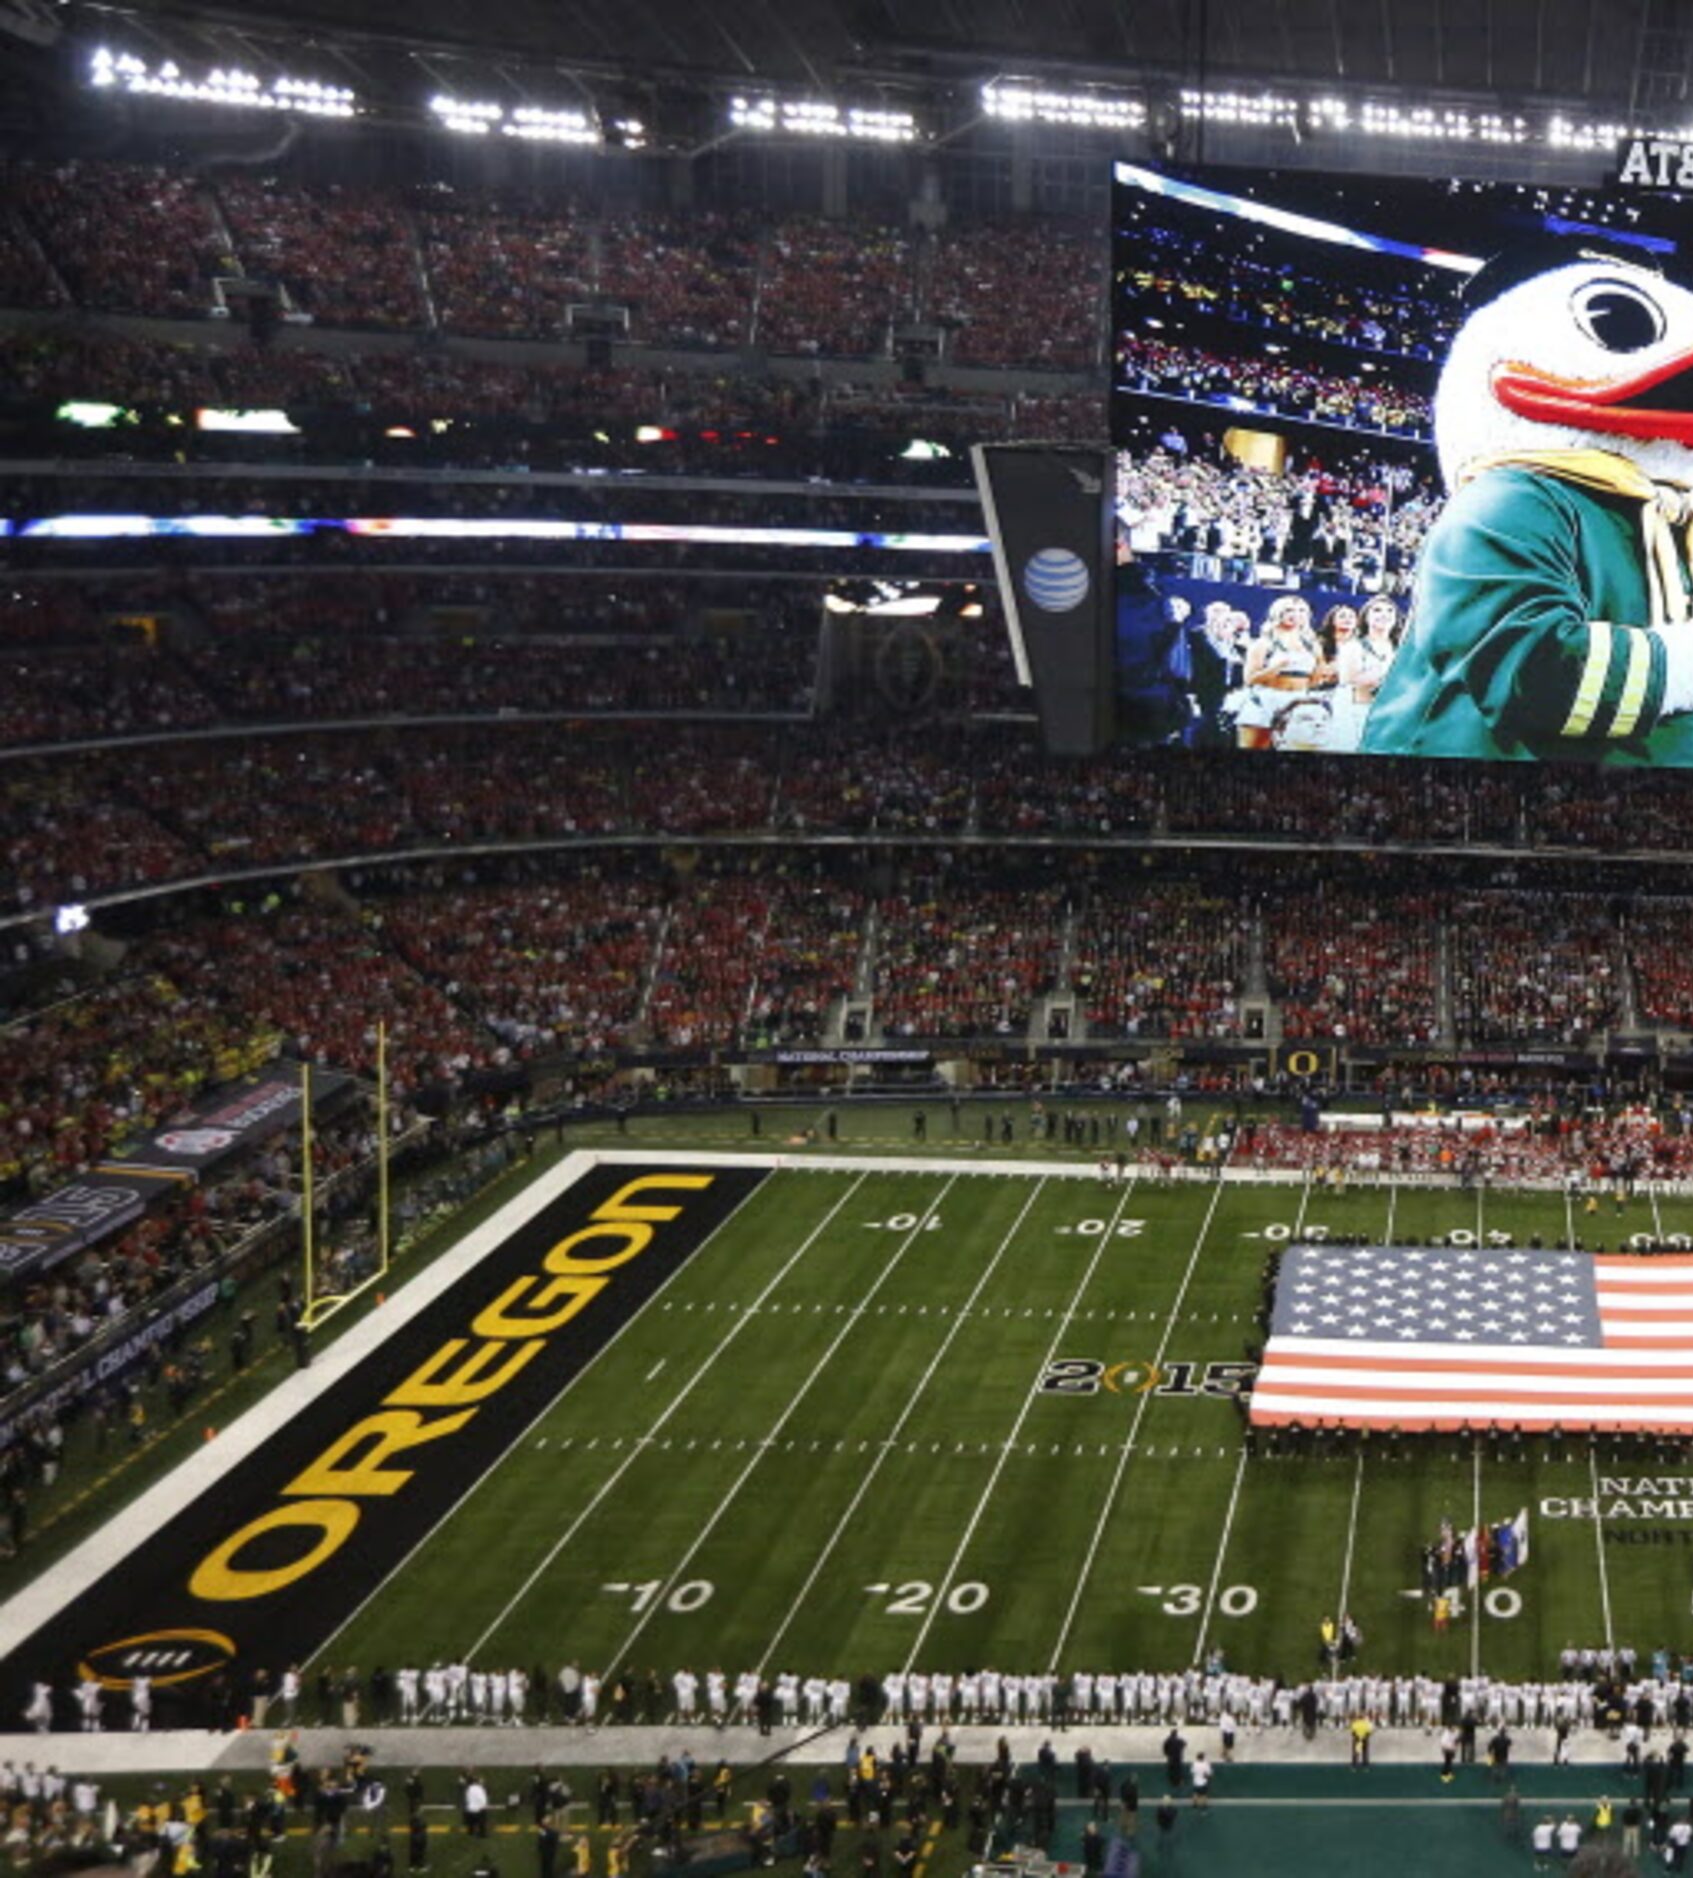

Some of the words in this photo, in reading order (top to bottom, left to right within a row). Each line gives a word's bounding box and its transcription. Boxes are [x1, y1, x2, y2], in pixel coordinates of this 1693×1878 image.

[1288, 1050, 1319, 1076] O
[886, 1213, 943, 1232] 10
[1076, 1218, 1147, 1237] 20
[188, 1172, 716, 1602] OREGON
[629, 1580, 716, 1613] 10
[885, 1581, 990, 1615] 20
[1161, 1584, 1260, 1617] 30
